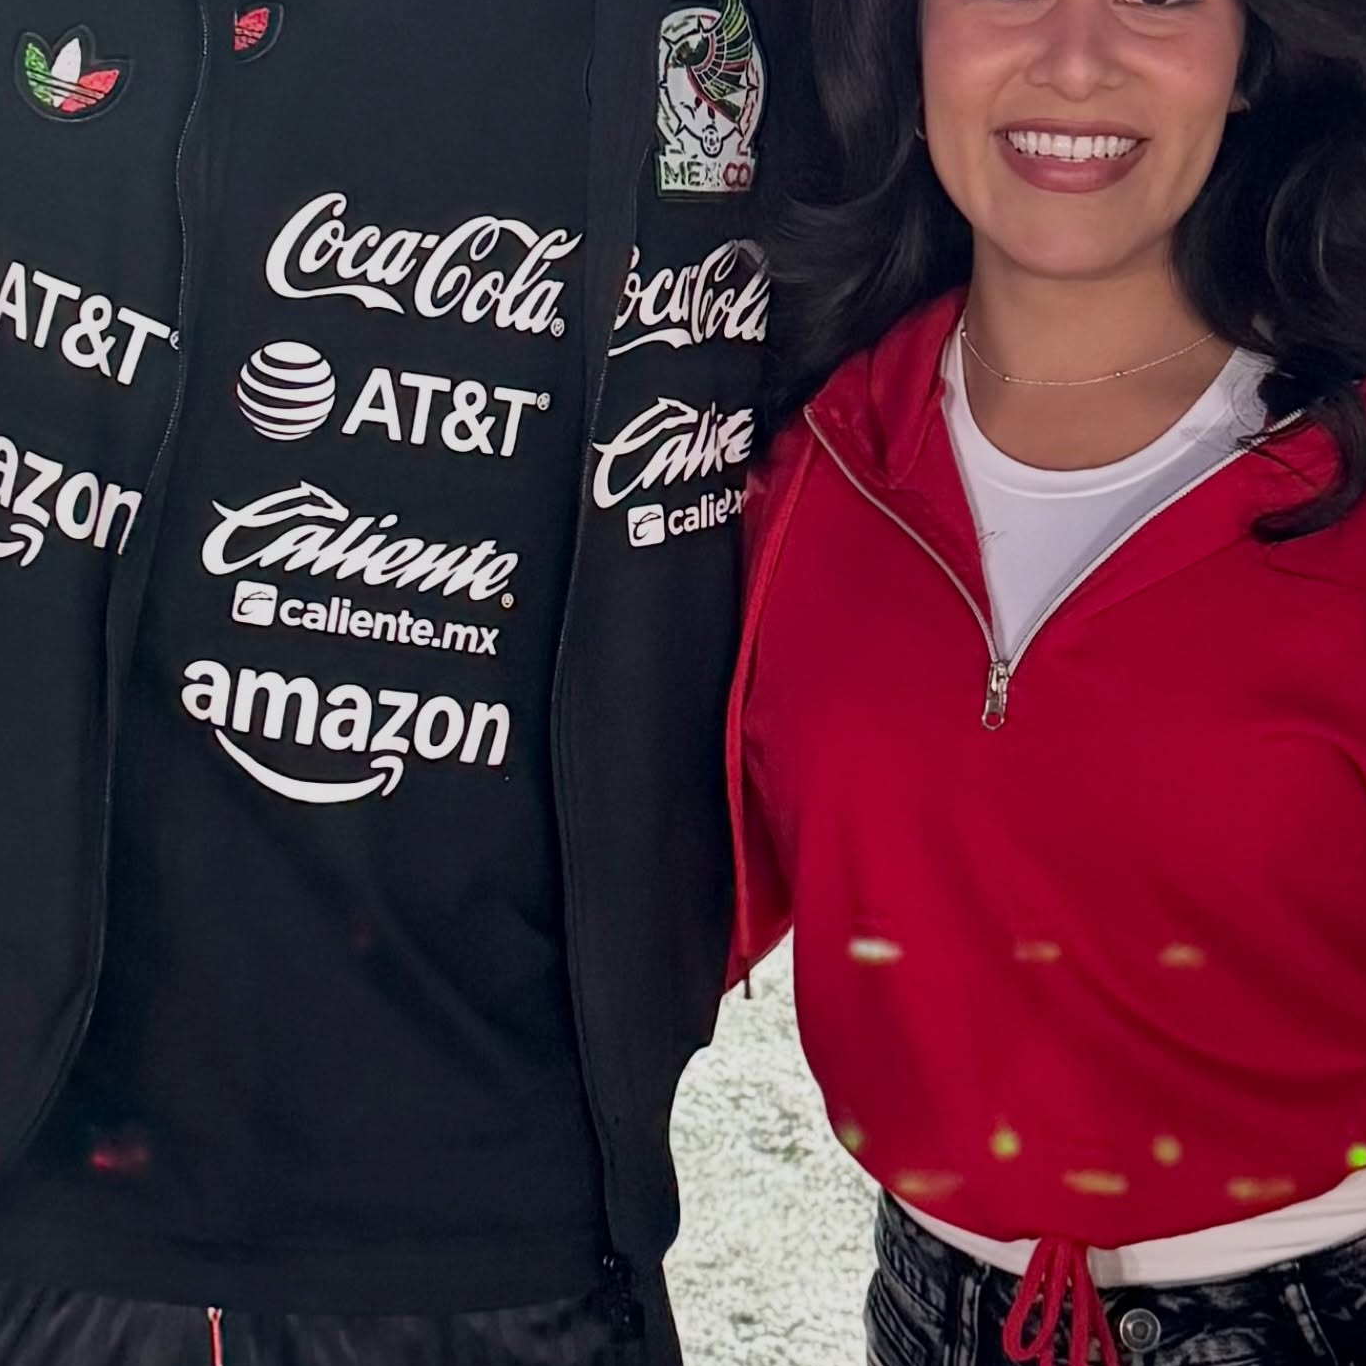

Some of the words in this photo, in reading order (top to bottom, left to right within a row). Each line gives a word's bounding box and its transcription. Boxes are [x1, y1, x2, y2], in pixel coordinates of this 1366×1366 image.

[265, 192, 583, 335] Coca-Cola
[341, 367, 539, 458] AT&T
[201, 480, 519, 602] Caliente
[278, 596, 499, 655] caliente.mx
[181, 660, 510, 766] amazon
